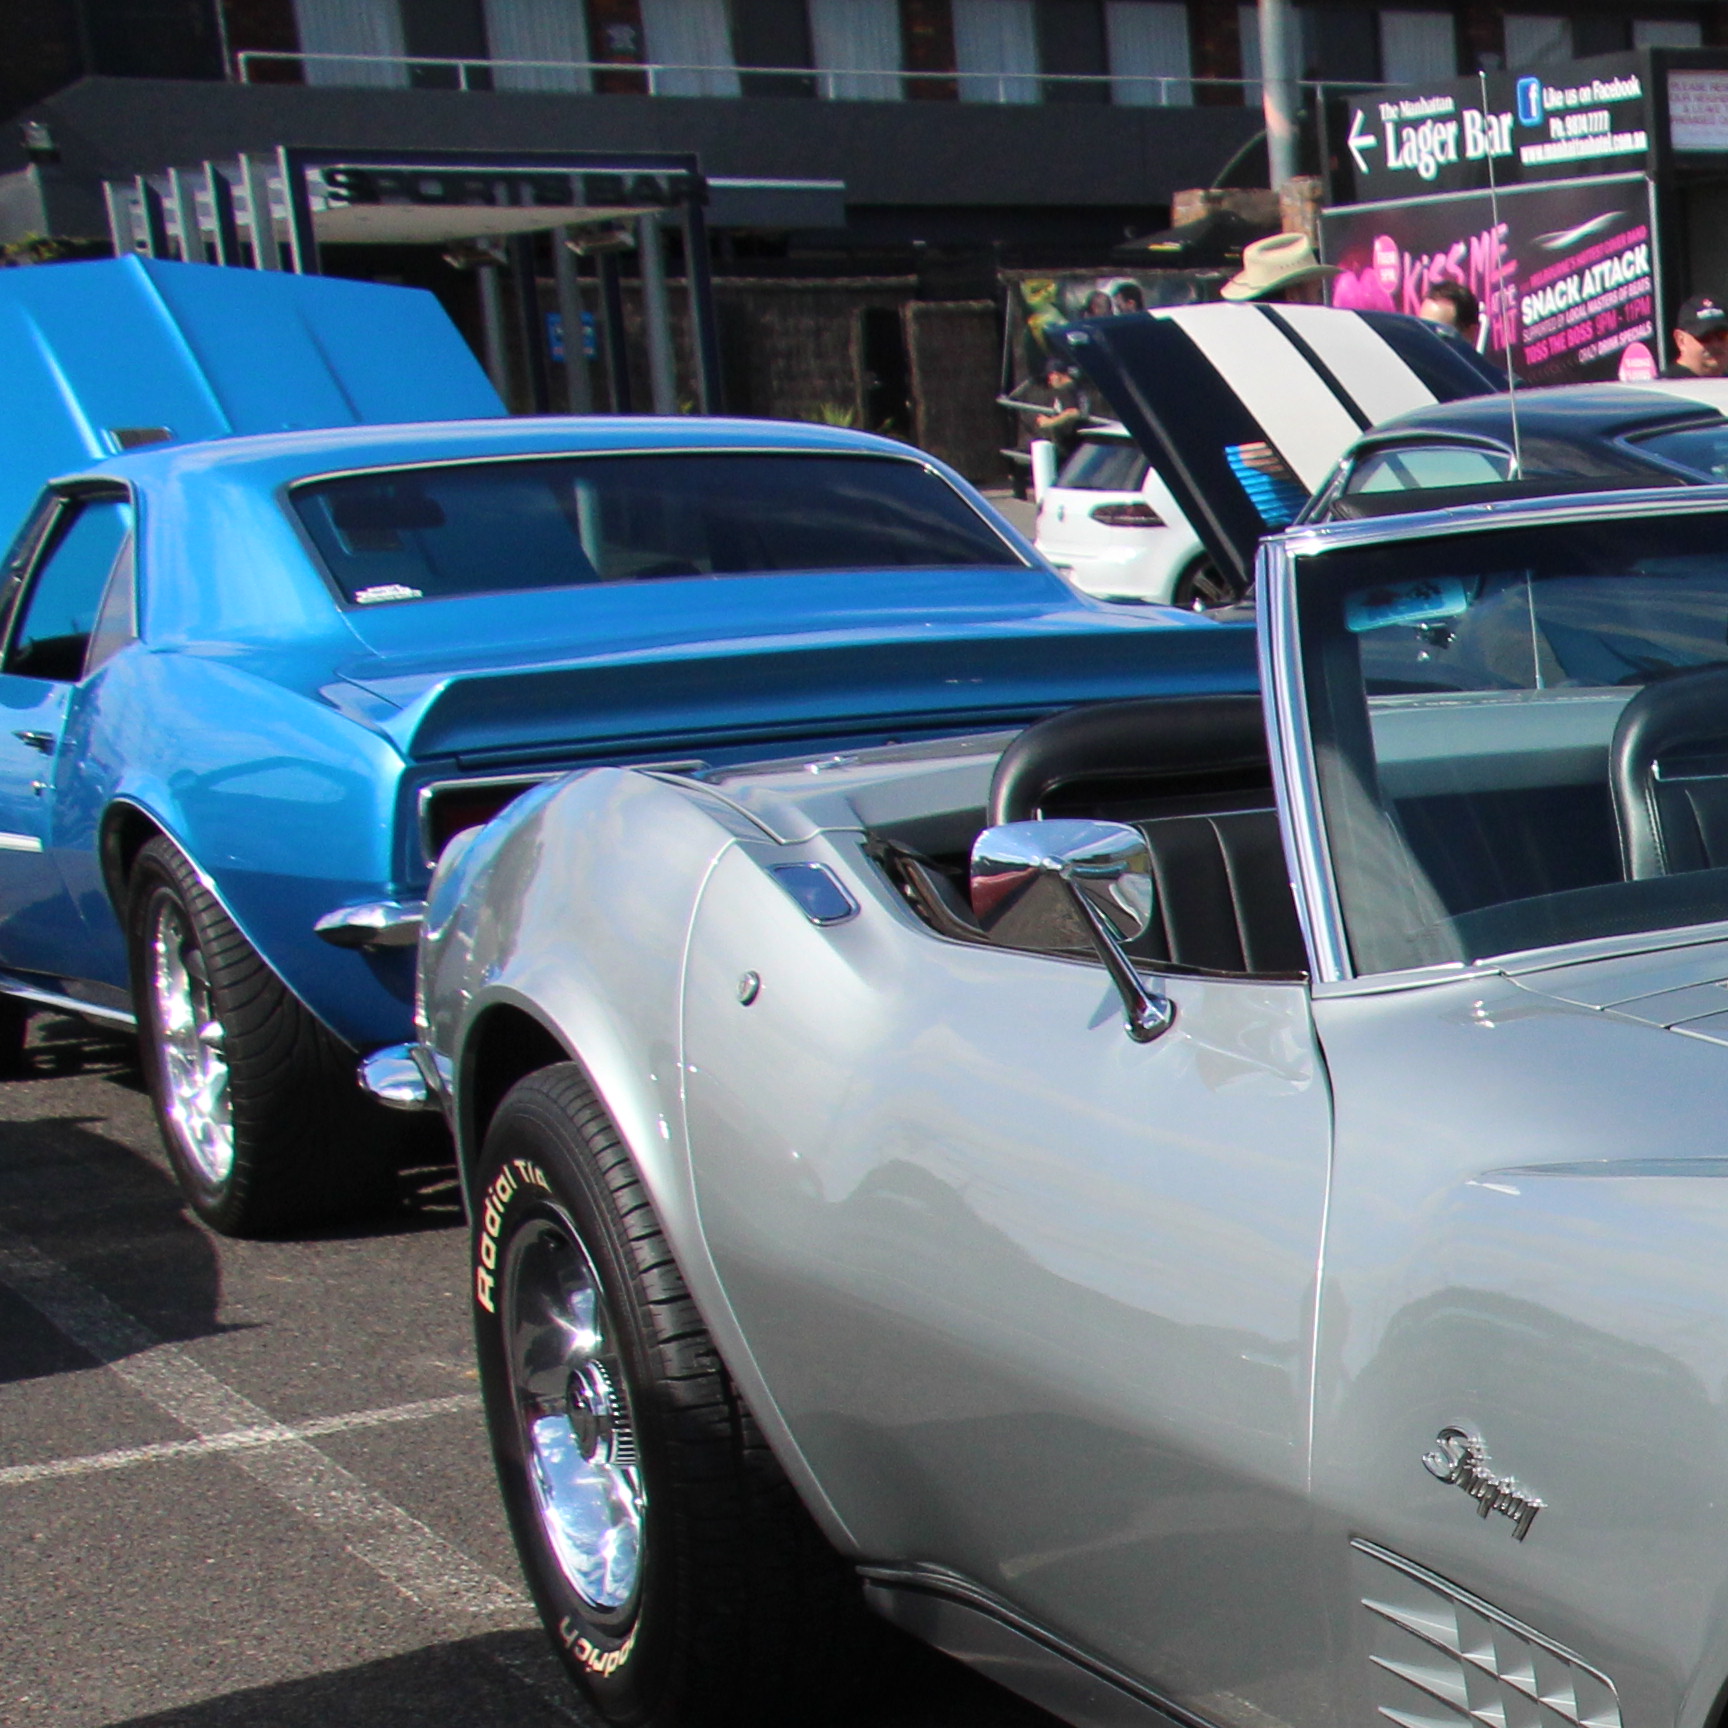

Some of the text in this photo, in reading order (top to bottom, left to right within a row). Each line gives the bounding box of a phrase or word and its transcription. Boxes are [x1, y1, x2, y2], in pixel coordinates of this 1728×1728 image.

[1379, 96, 1455, 121] The Manhattan
[1543, 74, 1643, 111] Like us on Facebook
[1385, 109, 1513, 180] Lager Bar
[323, 168, 706, 206] SPORTS BAR
[1521, 243, 1651, 326] SNACK ATTACK
[476, 1164, 519, 1314] Radial
